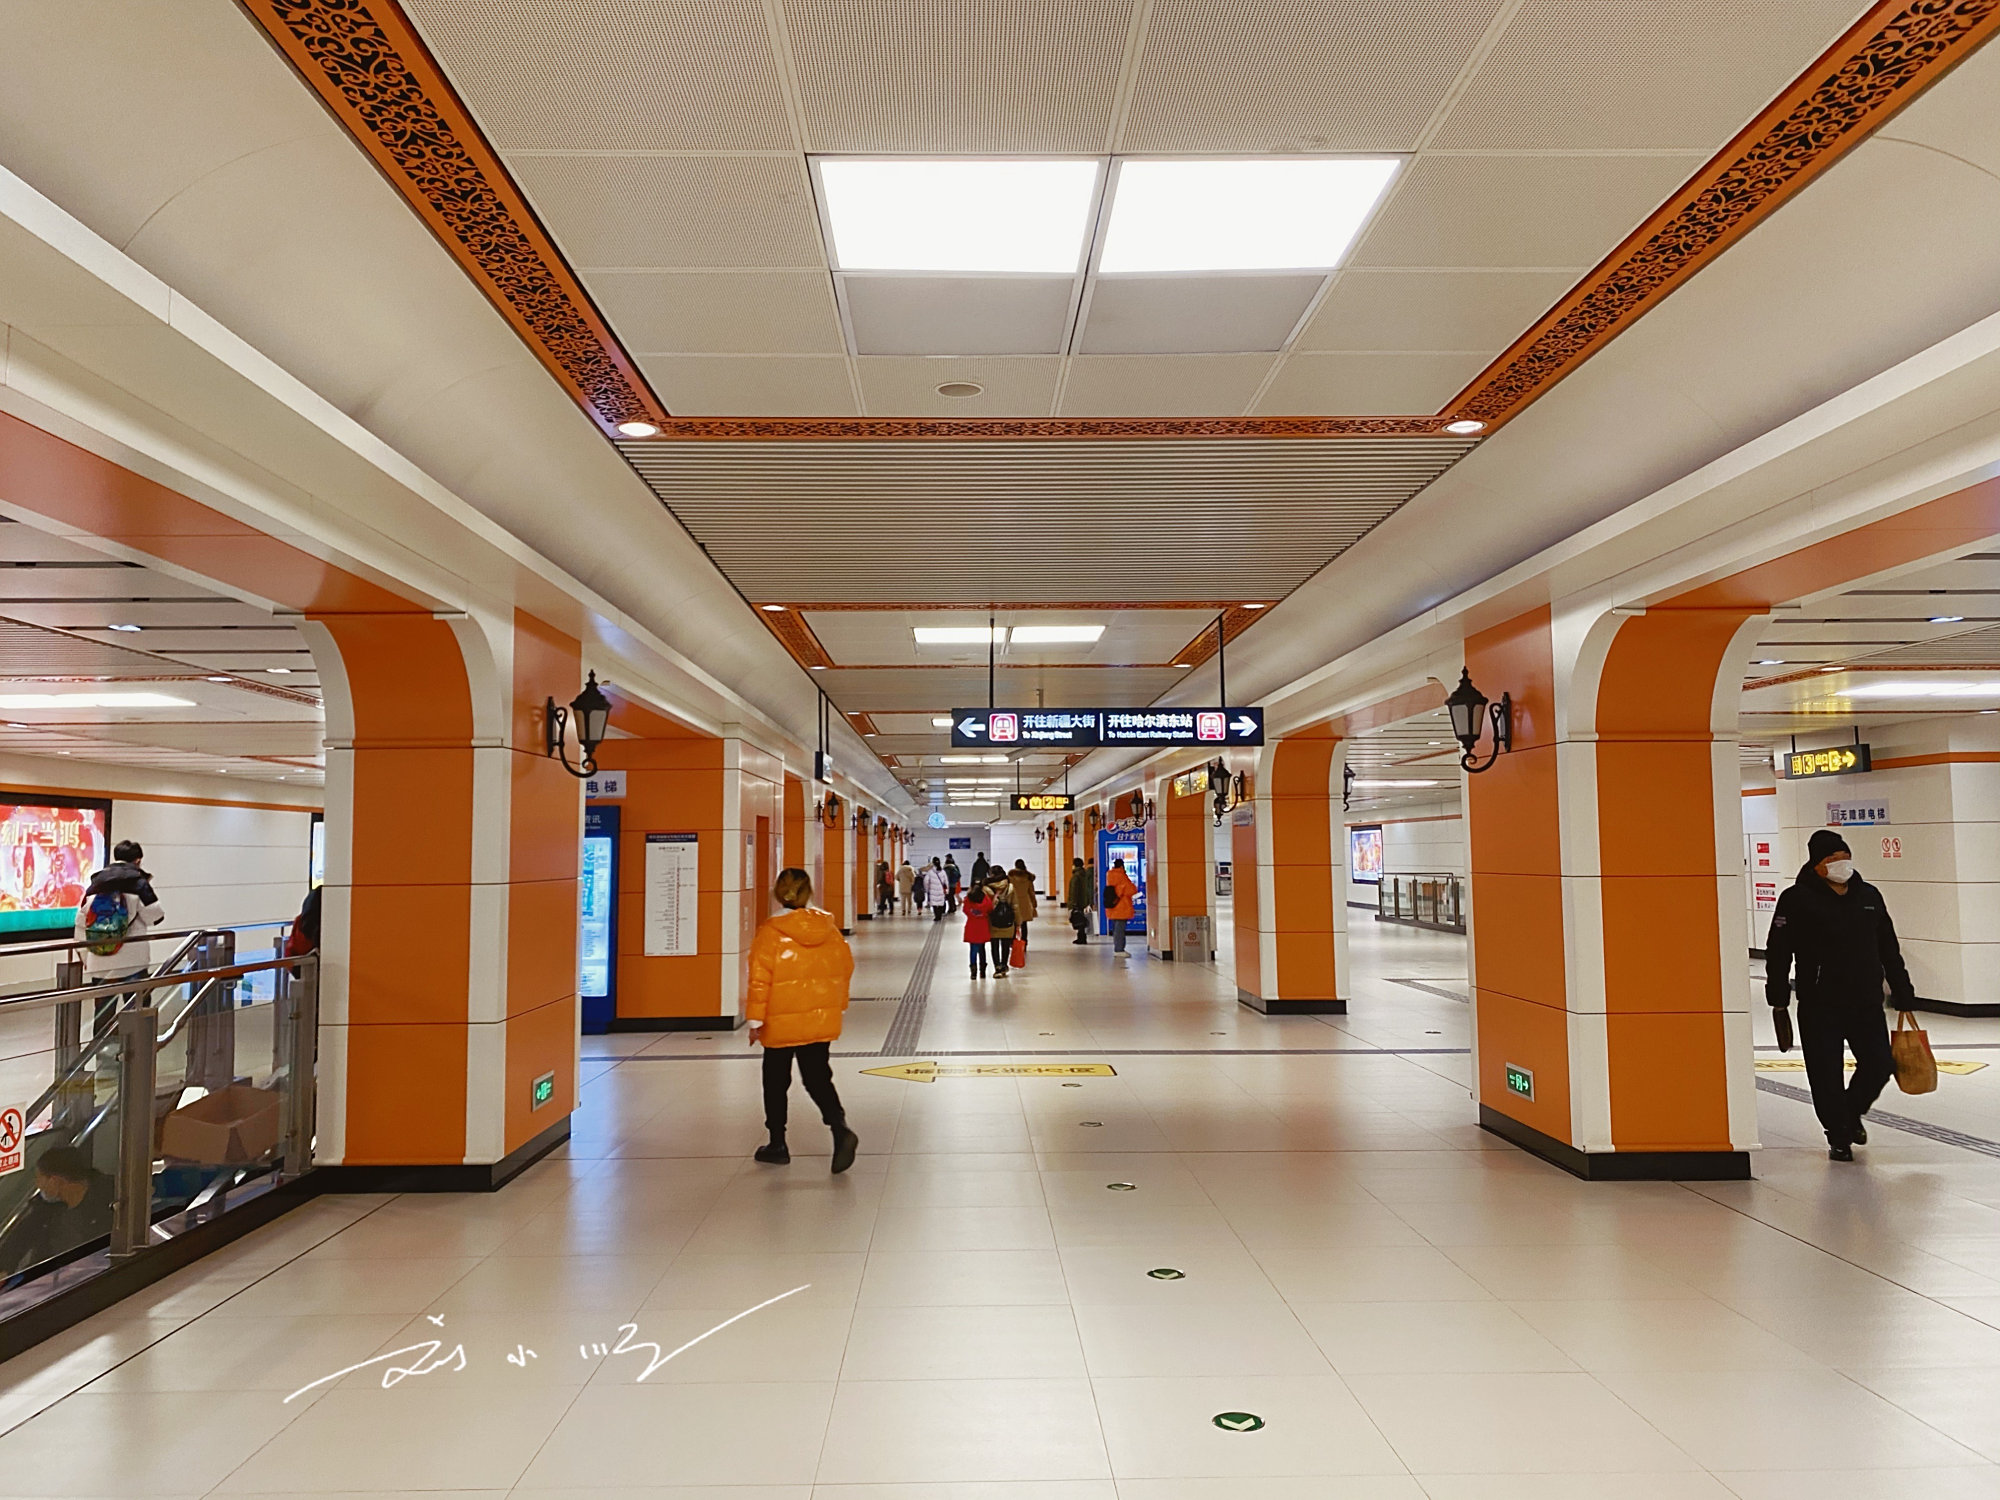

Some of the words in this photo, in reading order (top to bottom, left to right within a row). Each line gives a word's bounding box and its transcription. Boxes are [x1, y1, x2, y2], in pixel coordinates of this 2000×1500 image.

[1022, 714, 1095, 728] 开往新疆大街
[1108, 714, 1193, 728] 开往哈尔滨东站
[586, 780, 617, 793] 电梯
[1840, 808, 1886, 821] 无障碍电梯
